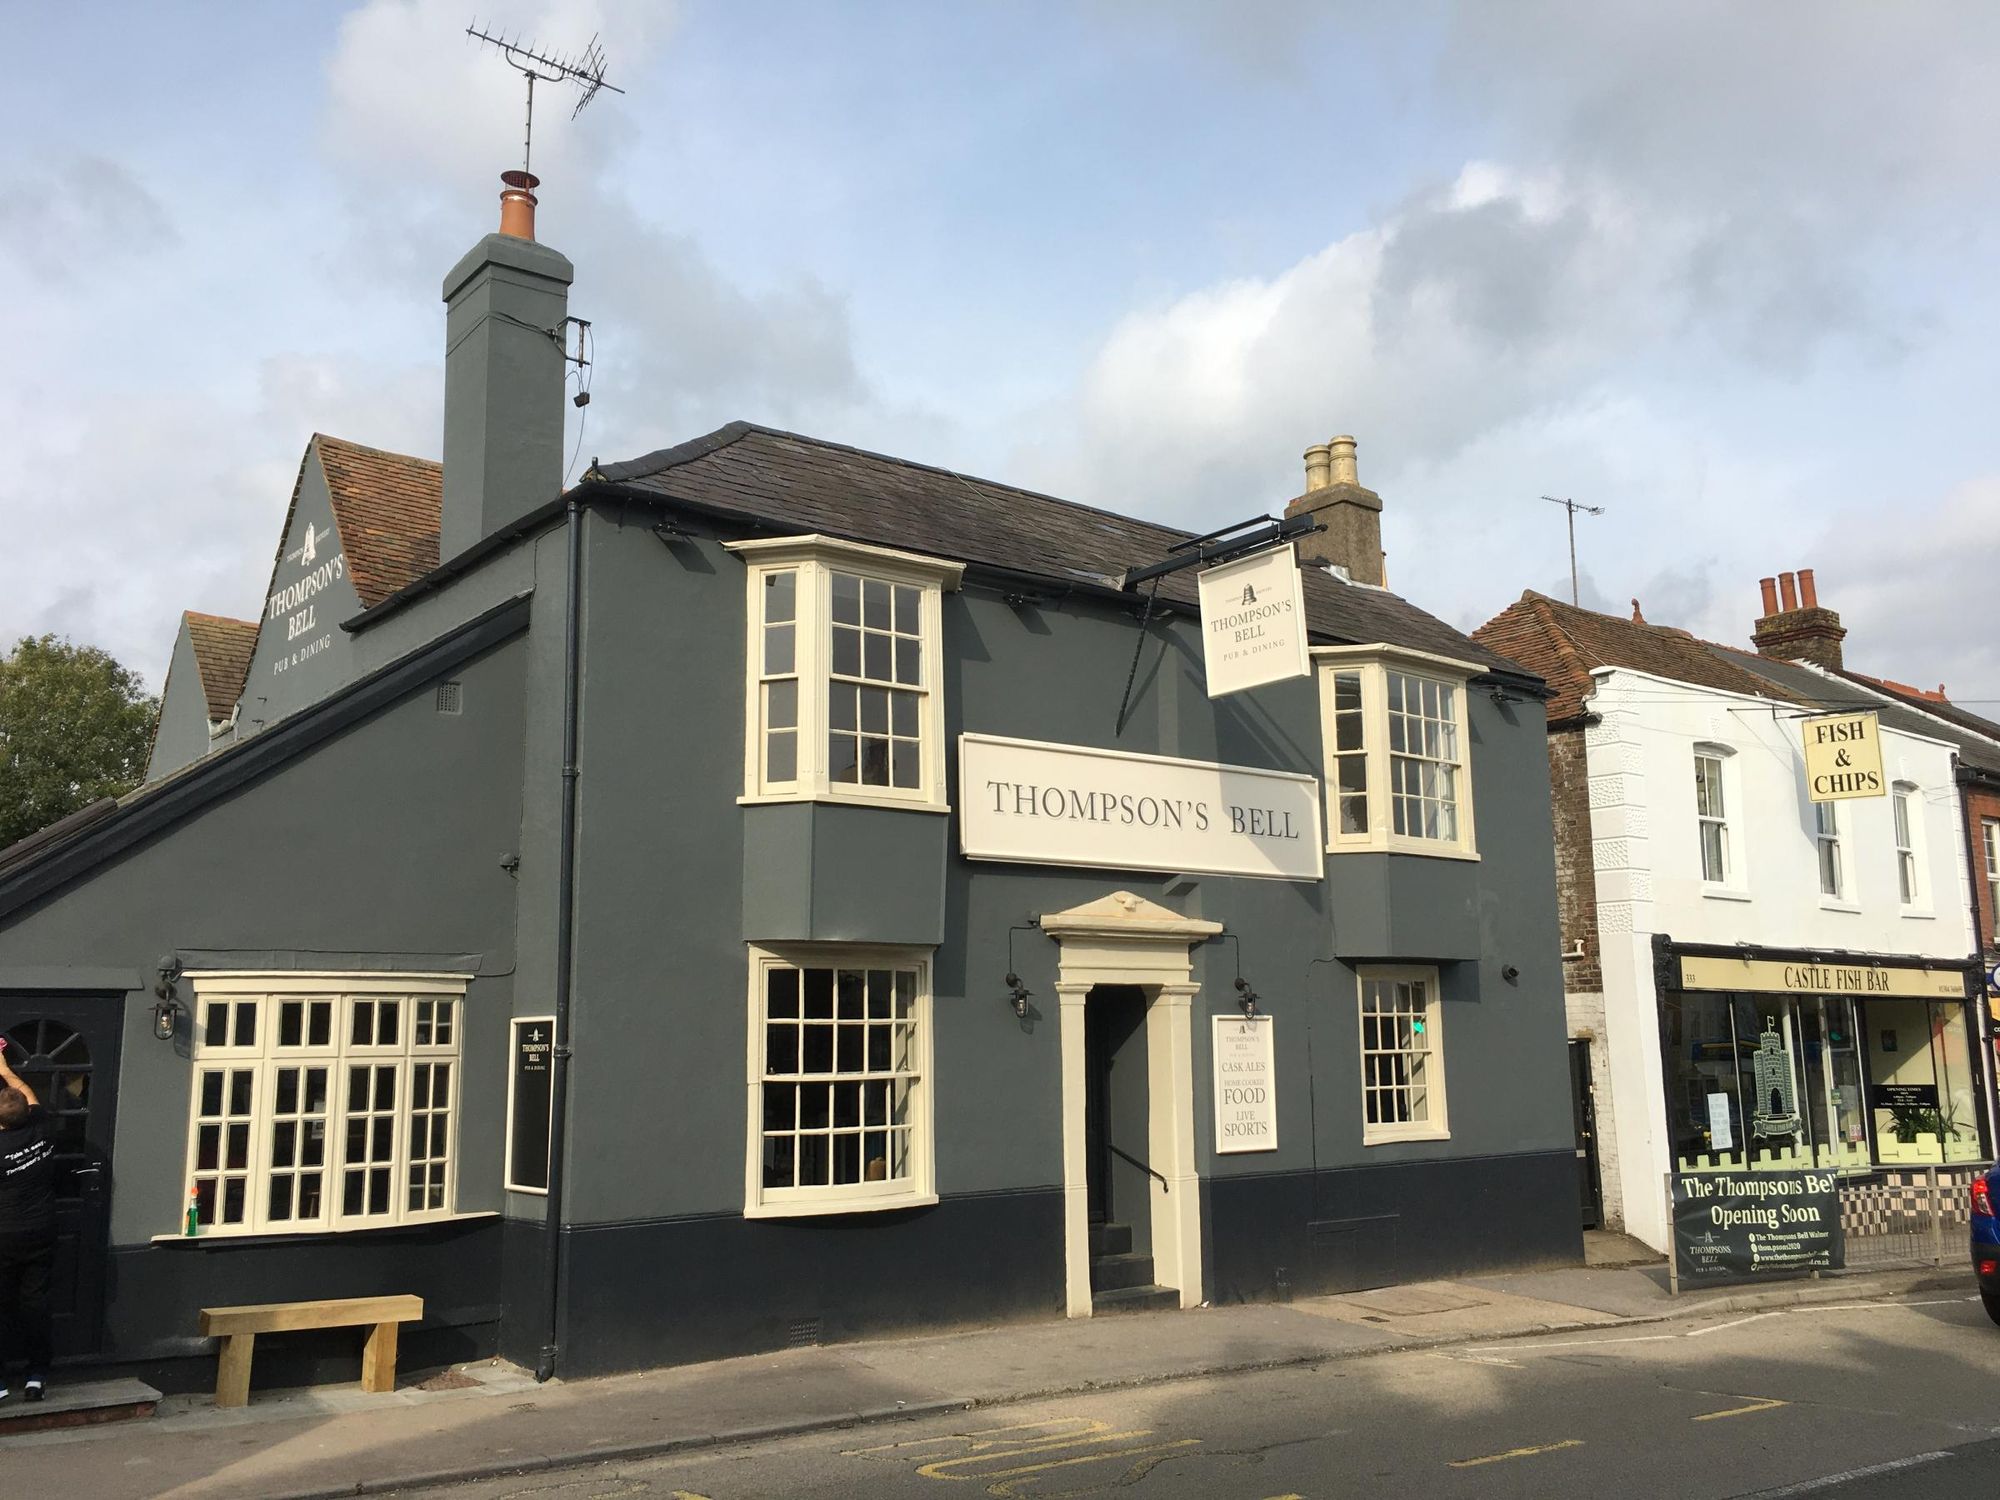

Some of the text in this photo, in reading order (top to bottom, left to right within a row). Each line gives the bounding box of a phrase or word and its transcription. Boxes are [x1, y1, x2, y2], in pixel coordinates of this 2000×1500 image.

[269, 554, 344, 620] THOMPSON'S
[287, 605, 317, 641] BELL
[1210, 599, 1292, 633] THOMPSON'S
[1234, 625, 1265, 642] BELL
[273, 634, 331, 675] PUB & DINING
[1223, 638, 1285, 661] PUB & DINING
[1816, 721, 1864, 744] FISH
[1835, 748, 1852, 767] &
[1814, 771, 1879, 794] CHIPS
[987, 780, 1299, 840] THOMPSON'S BELL
[1685, 973, 1696, 984] 333
[1784, 966, 1890, 991] CASTLE FISH BAR
[1222, 1061, 1266, 1072] CASK ALES
[1224, 1087, 1266, 1104] FOOD
[1236, 1111, 1255, 1121] LIVE
[1224, 1121, 1268, 1137] SPORTS
[1681, 1177, 1713, 1198] The
[1715, 1176, 1803, 1200] Thompsons
[1711, 1204, 1821, 1230] Opening Soon
[1756, 1233, 1766, 1241] The
[1797, 1231, 1809, 1239] Bell
[1690, 1245, 1732, 1254] THOMPSONS
[1702, 1255, 1719, 1263] BELL
